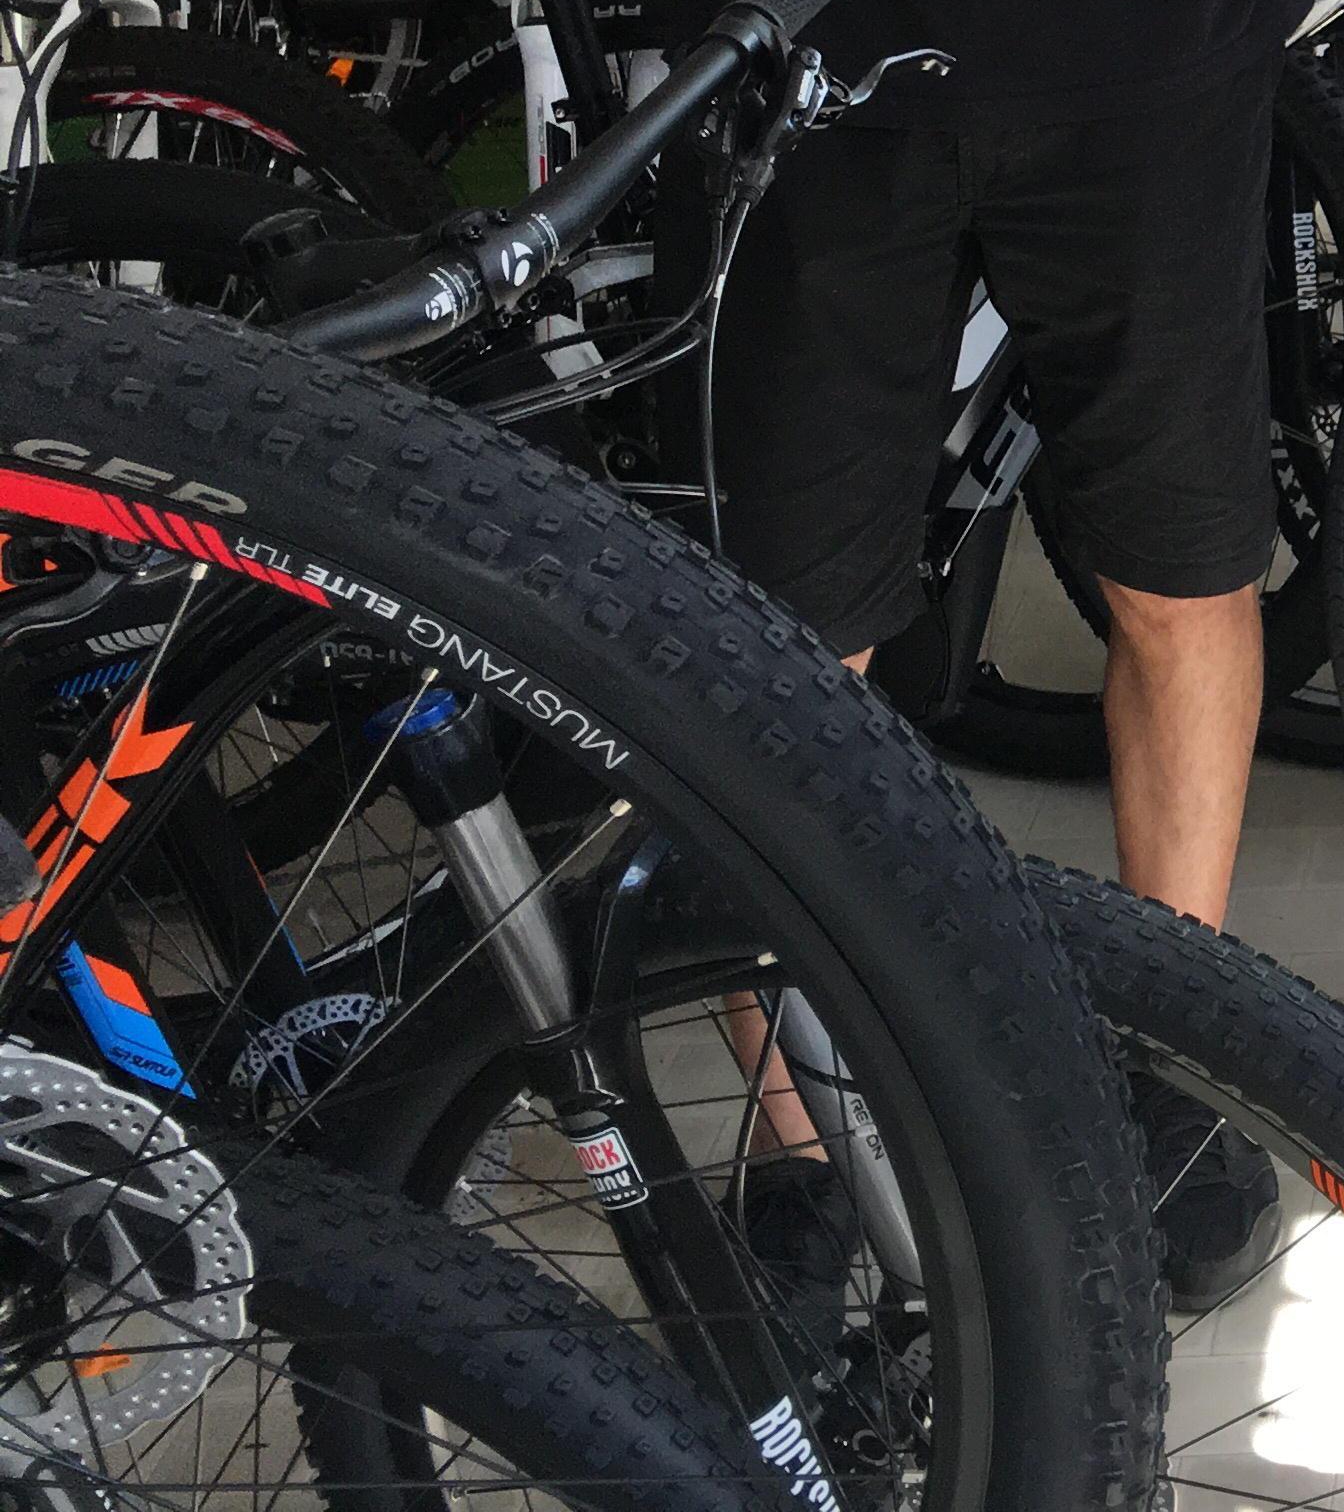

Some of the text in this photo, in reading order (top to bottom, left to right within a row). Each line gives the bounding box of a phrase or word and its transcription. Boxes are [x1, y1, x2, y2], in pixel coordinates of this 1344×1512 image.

[235, 536, 293, 570] TLR
[301, 563, 400, 619] ELITE
[405, 613, 630, 771] MUSTANG
[849, 1098, 885, 1161] REON
